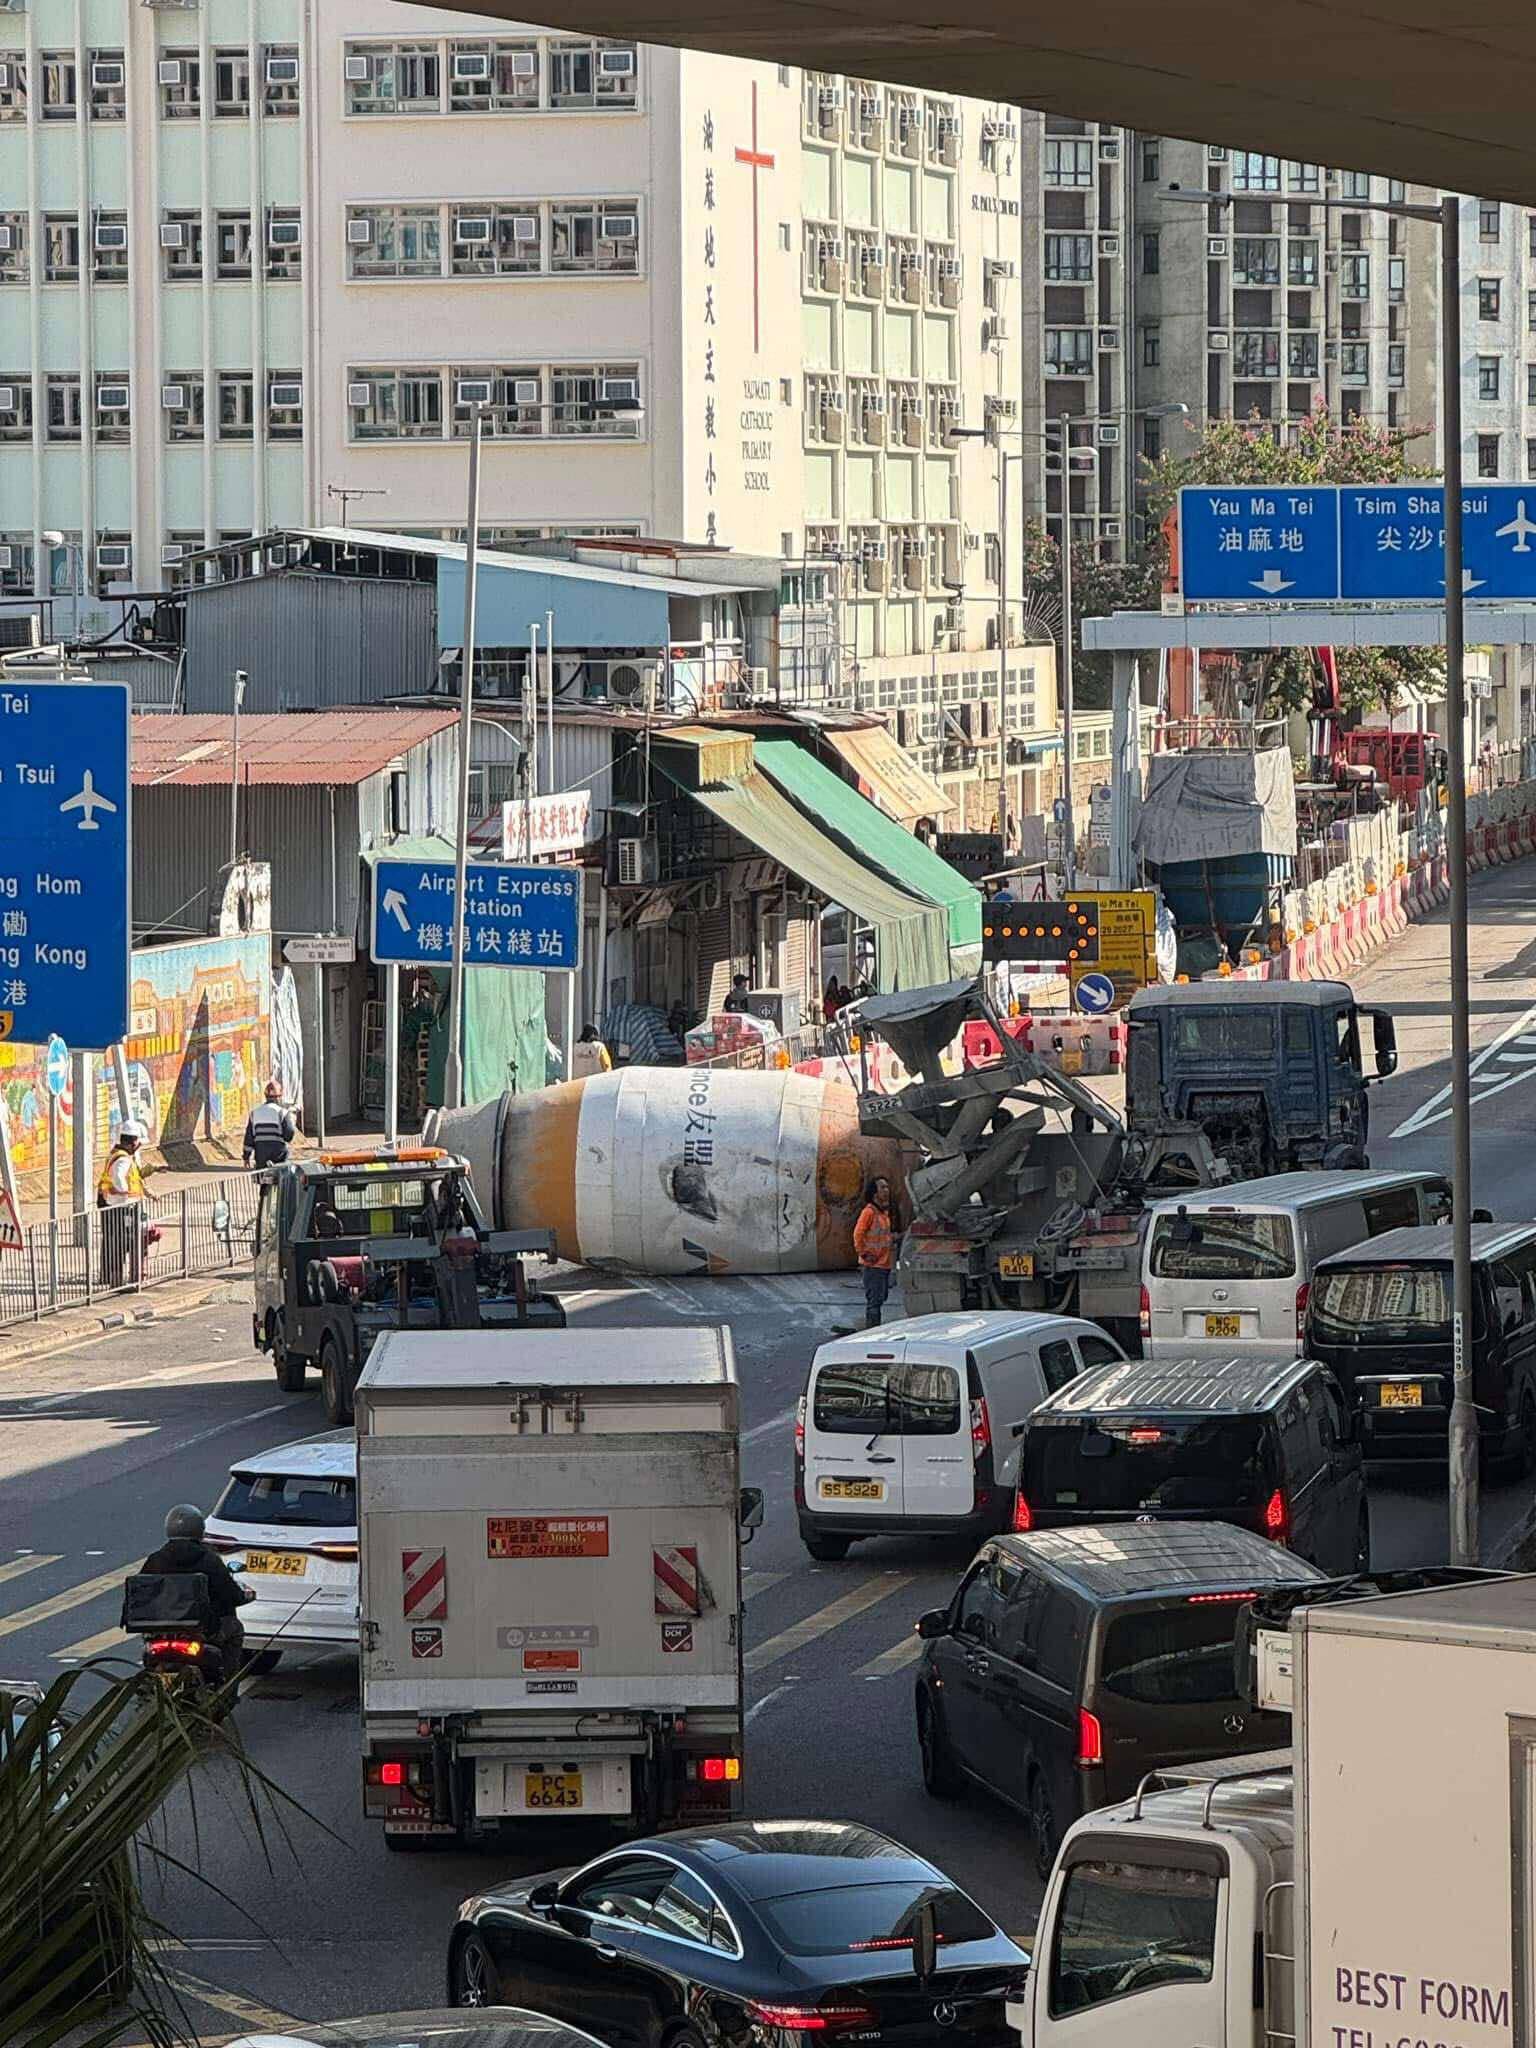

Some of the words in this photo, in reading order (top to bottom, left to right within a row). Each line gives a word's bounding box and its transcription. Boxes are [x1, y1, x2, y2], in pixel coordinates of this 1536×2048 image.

[740, 410, 773, 431] CATHOLIC
[741, 440, 772, 460] PRIMARY
[744, 471, 770, 491] SCHOOL
[1209, 498, 1240, 516] Yau
[1251, 498, 1275, 516] Ma
[1288, 497, 1313, 516] Tei
[1355, 496, 1396, 515] Tsim
[1408, 496, 1441, 515] Sha
[1462, 495, 1488, 514] sui
[1218, 527, 1304, 552] 油麻地
[1377, 525, 1447, 552] 尖沙
[1, 692, 29, 715] Tei
[16, 763, 55, 785] Tsui
[36, 872, 81, 895] Hom
[418, 872, 484, 895] Airprt
[498, 876, 574, 898] Express
[35, 943, 87, 970] Kong
[2, 979, 27, 1005] 港
[1207, 1326, 1237, 1336] 9209
[542, 1775, 566, 1791] PC
[530, 1790, 578, 1806] 6643
[1336, 1967, 1406, 2010] BEST
[1419, 1978, 1509, 2027] FORM
